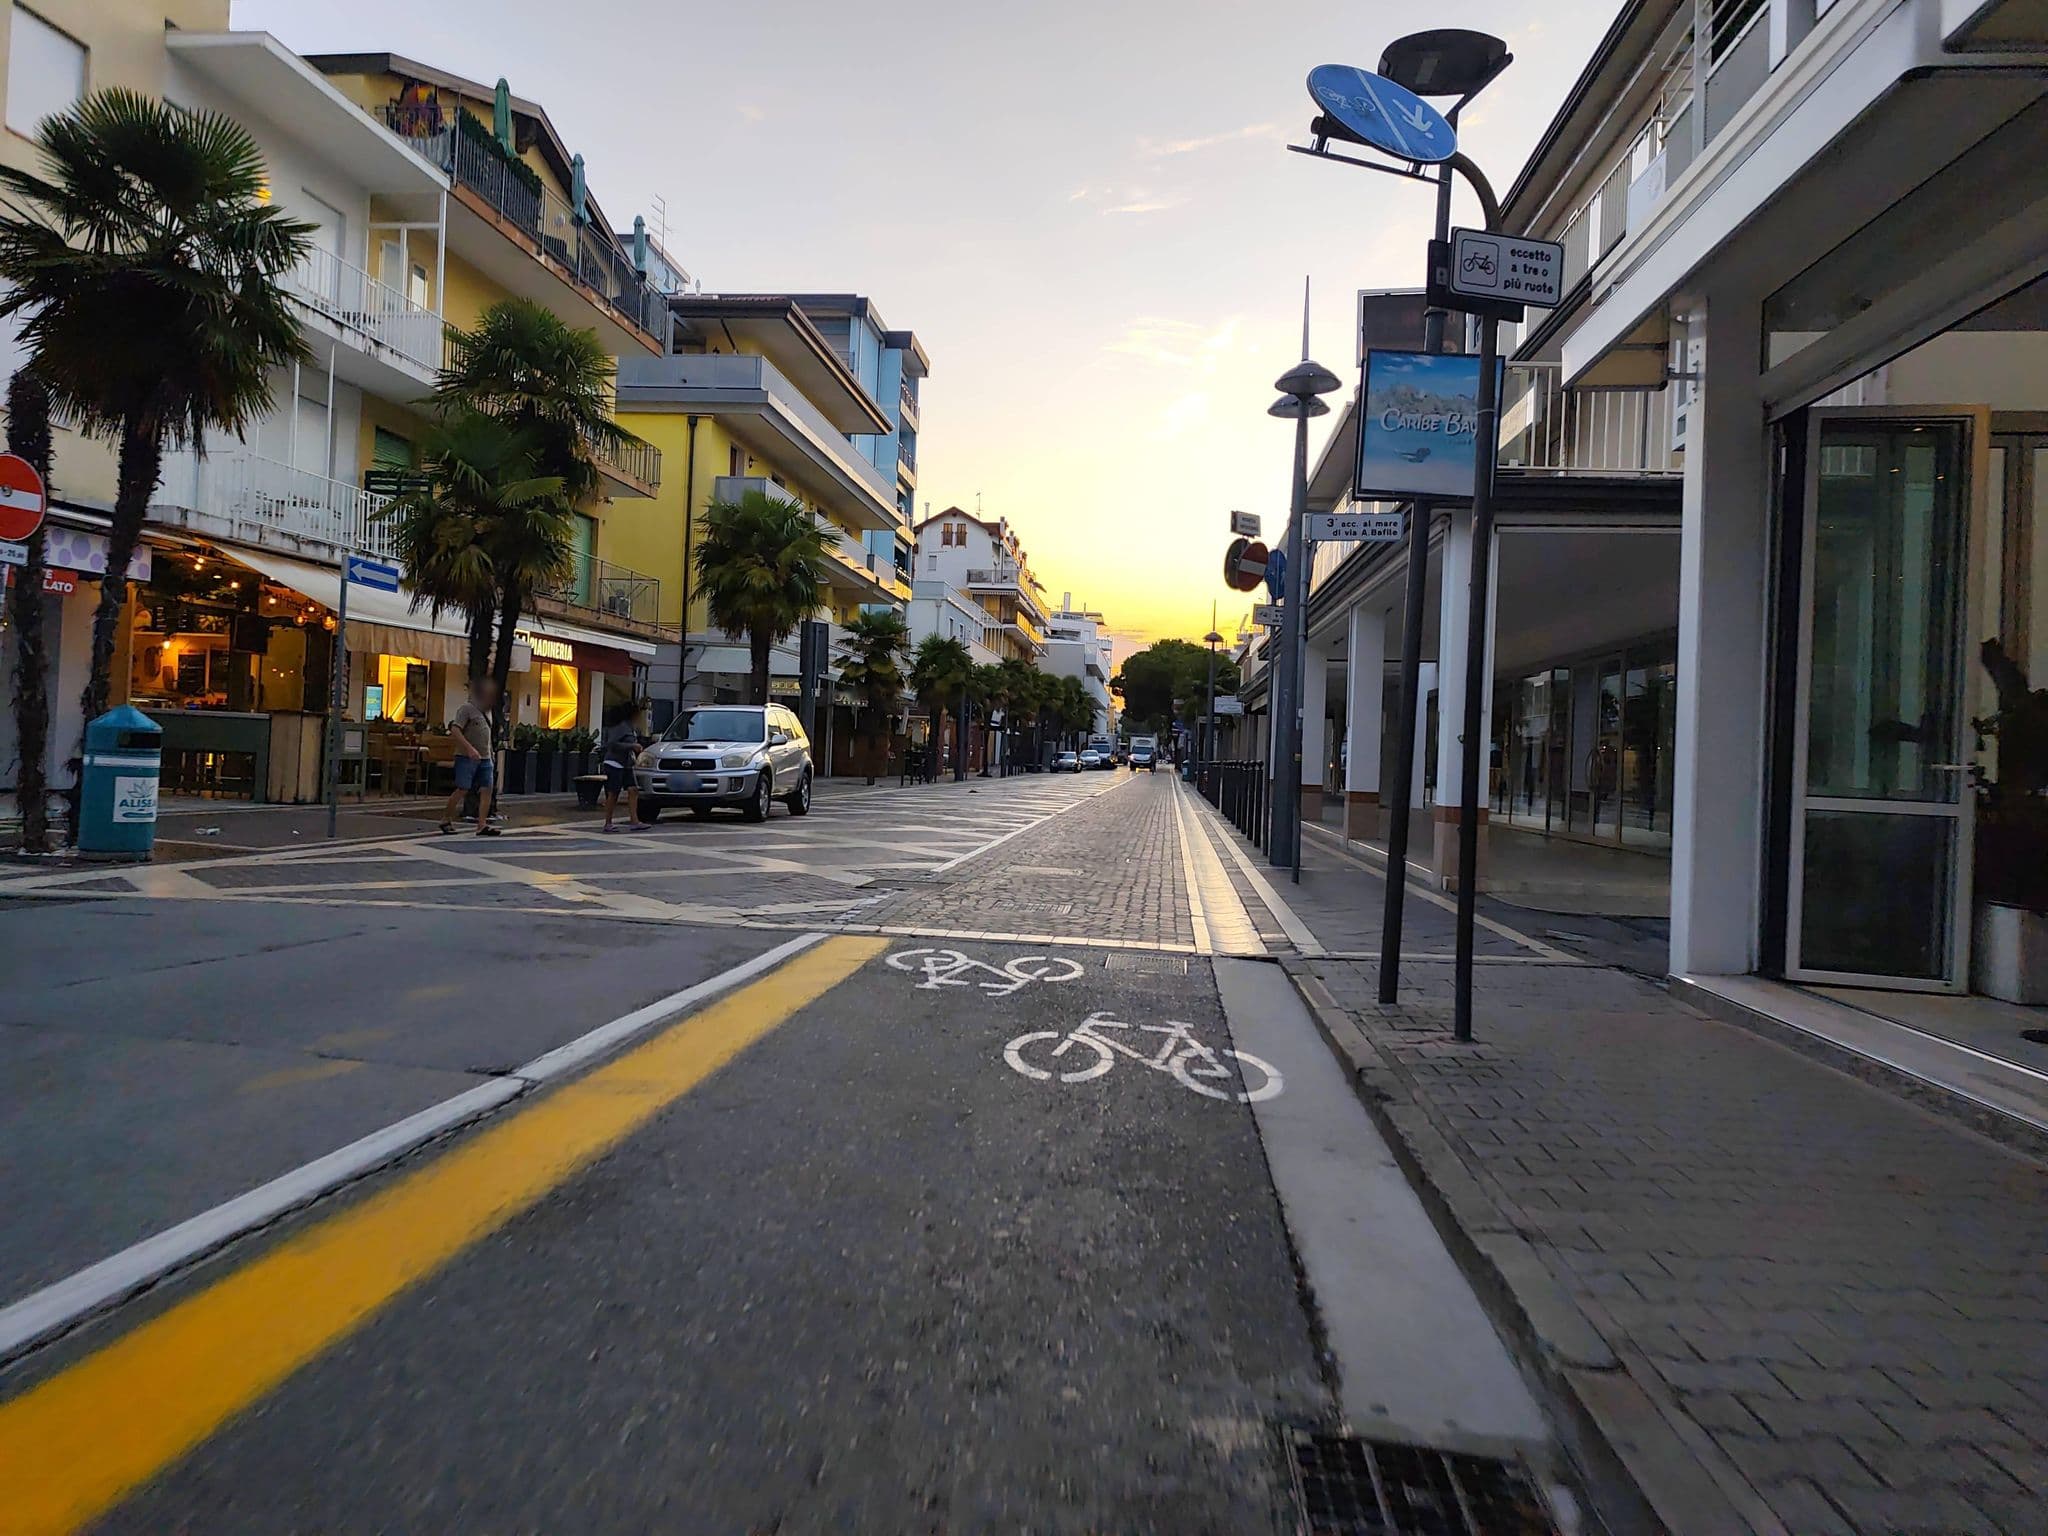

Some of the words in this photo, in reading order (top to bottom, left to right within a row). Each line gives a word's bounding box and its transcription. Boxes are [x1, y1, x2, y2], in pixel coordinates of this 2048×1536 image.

[1510, 247, 1552, 263] eccetto
[1511, 263, 1518, 273] a
[1523, 263, 1539, 276] tre
[1541, 268, 1549, 277] o
[1503, 279, 1521, 290] più
[1524, 281, 1554, 294] ruote
[1363, 520, 1371, 528] al
[42, 579, 74, 593] LATO
[529, 636, 573, 662] PIADINERIA
